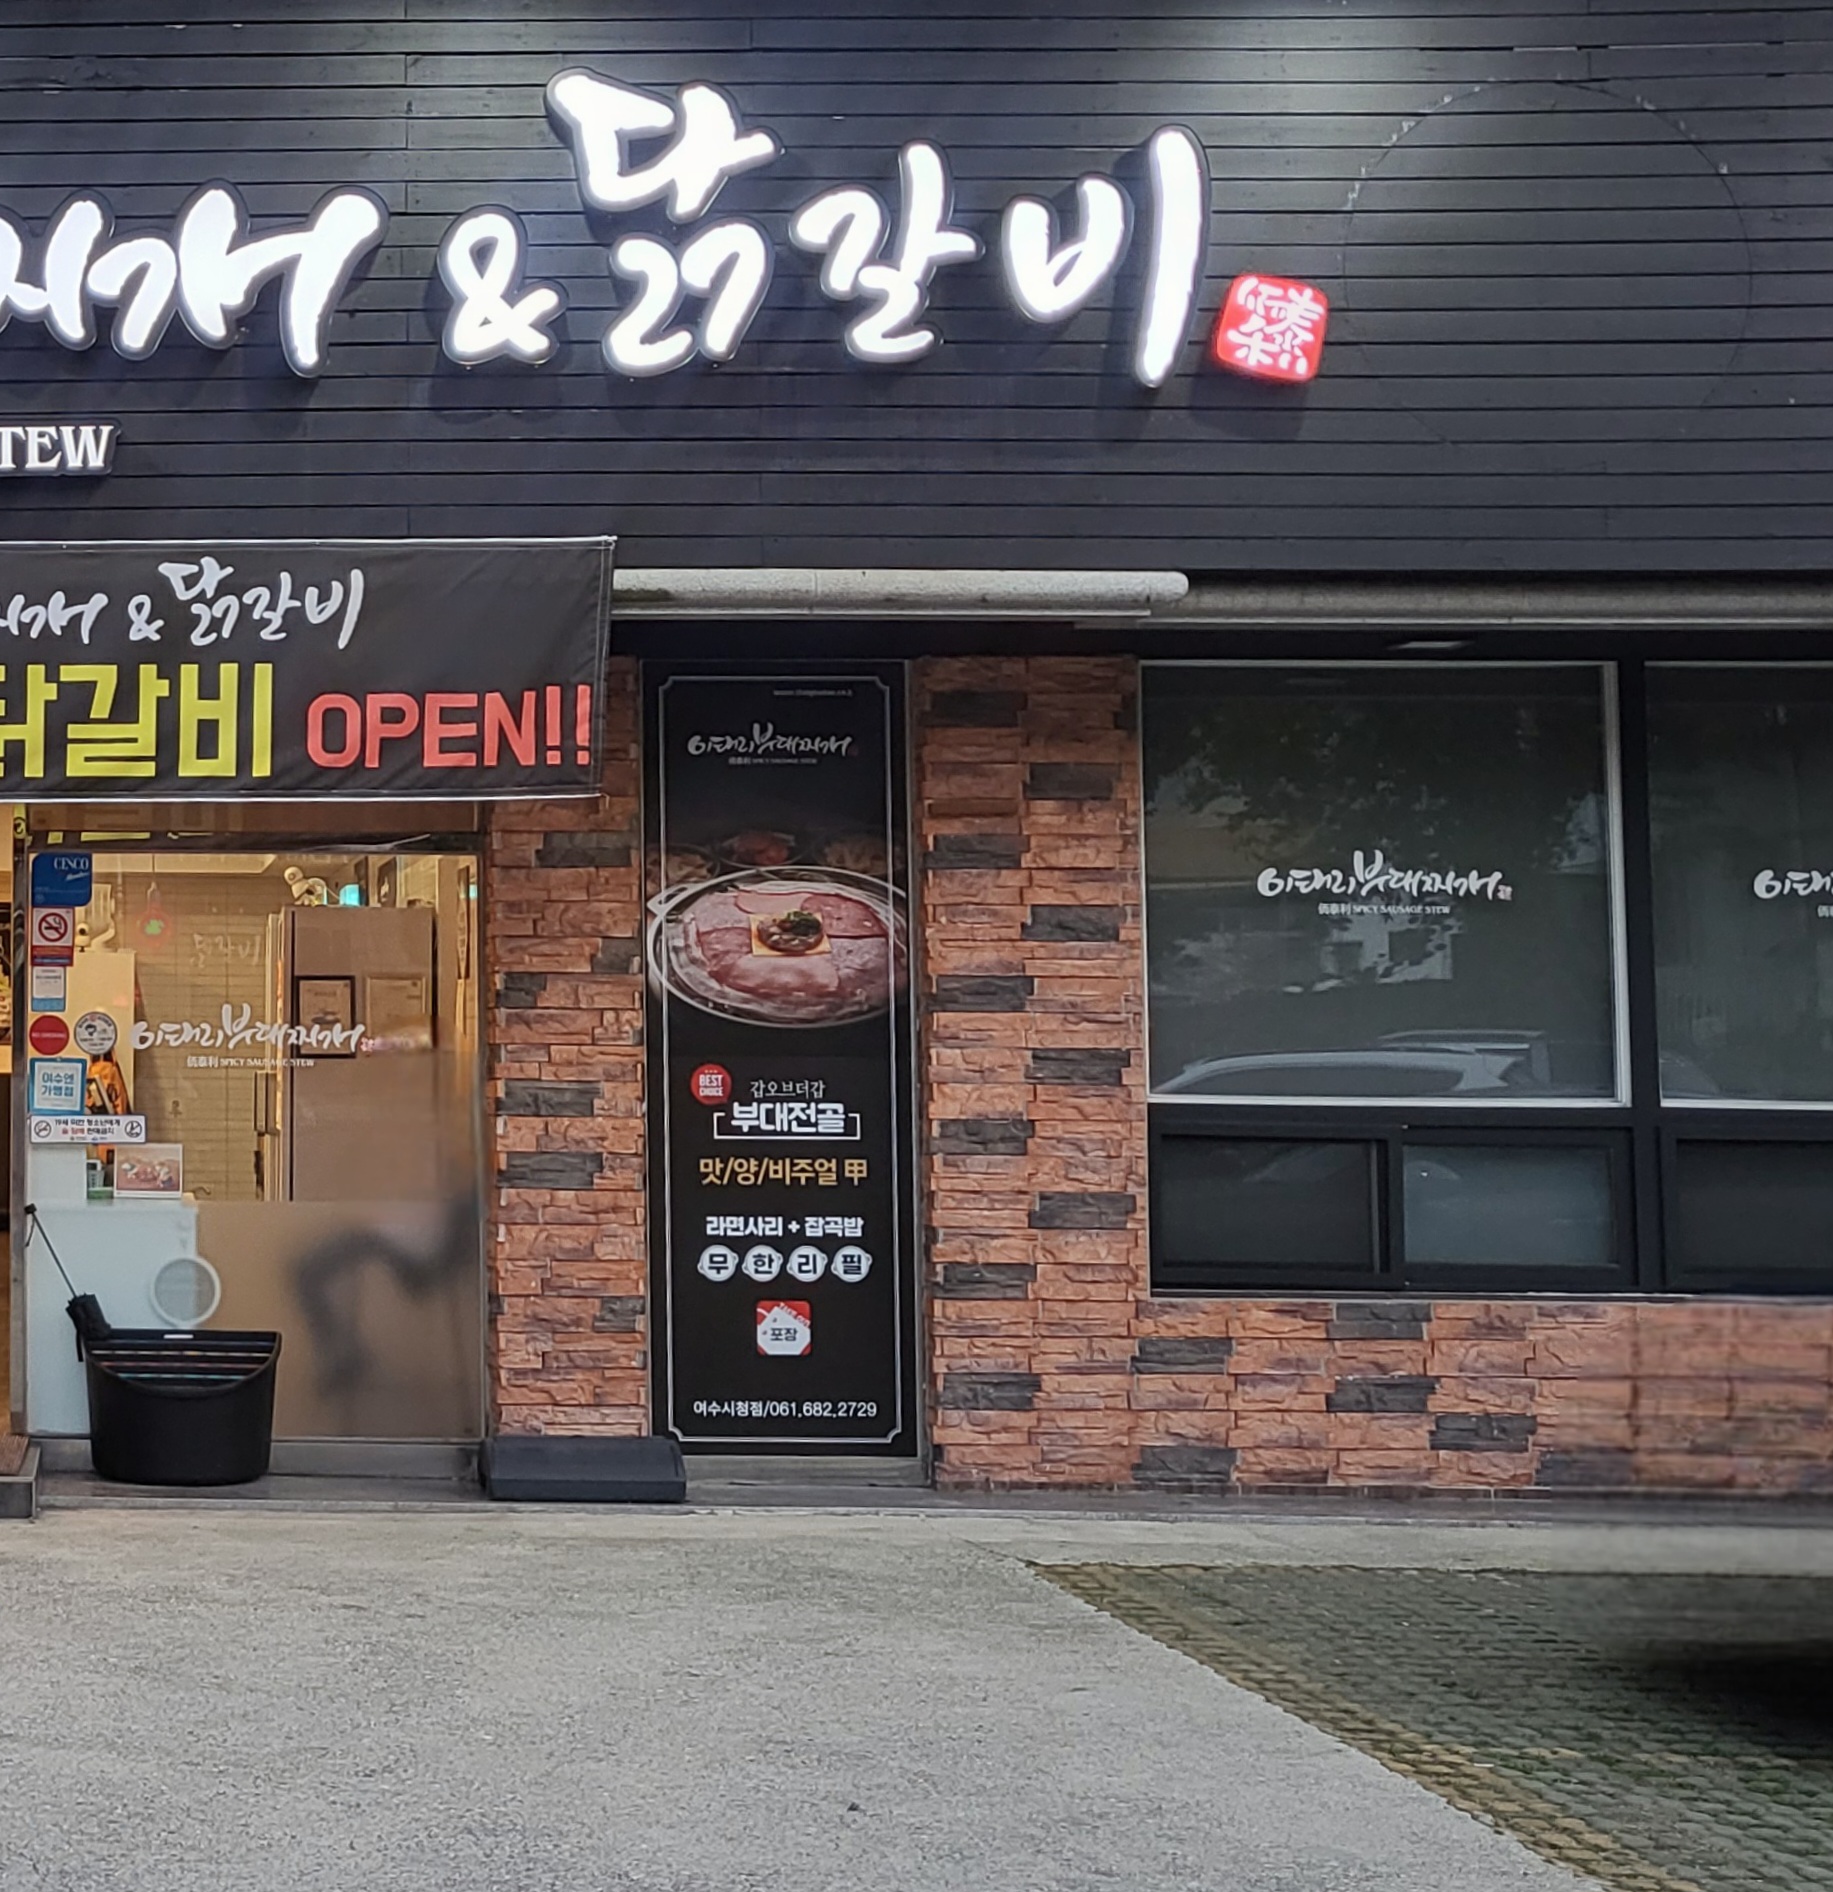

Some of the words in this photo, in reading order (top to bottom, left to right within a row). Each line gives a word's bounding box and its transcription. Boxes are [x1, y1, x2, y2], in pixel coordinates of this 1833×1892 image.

[446, 212, 559, 361] &
[554, 78, 1204, 386] 닭갈비
[128, 595, 164, 641] &
[158, 556, 365, 649] 닭갈비
[306, 684, 592, 769] OPEN!!
[699, 1074, 723, 1087] BEST
[750, 1080, 827, 1099] 갑오브더갑
[731, 1101, 846, 1133] 부대전골
[699, 1156, 838, 1187] 맛/양/비주얼
[844, 1158, 868, 1187] 甲
[705, 1216, 783, 1237] 라면사리
[804, 1216, 864, 1238] 잡곡밥
[770, 1327, 798, 1342] 포장
